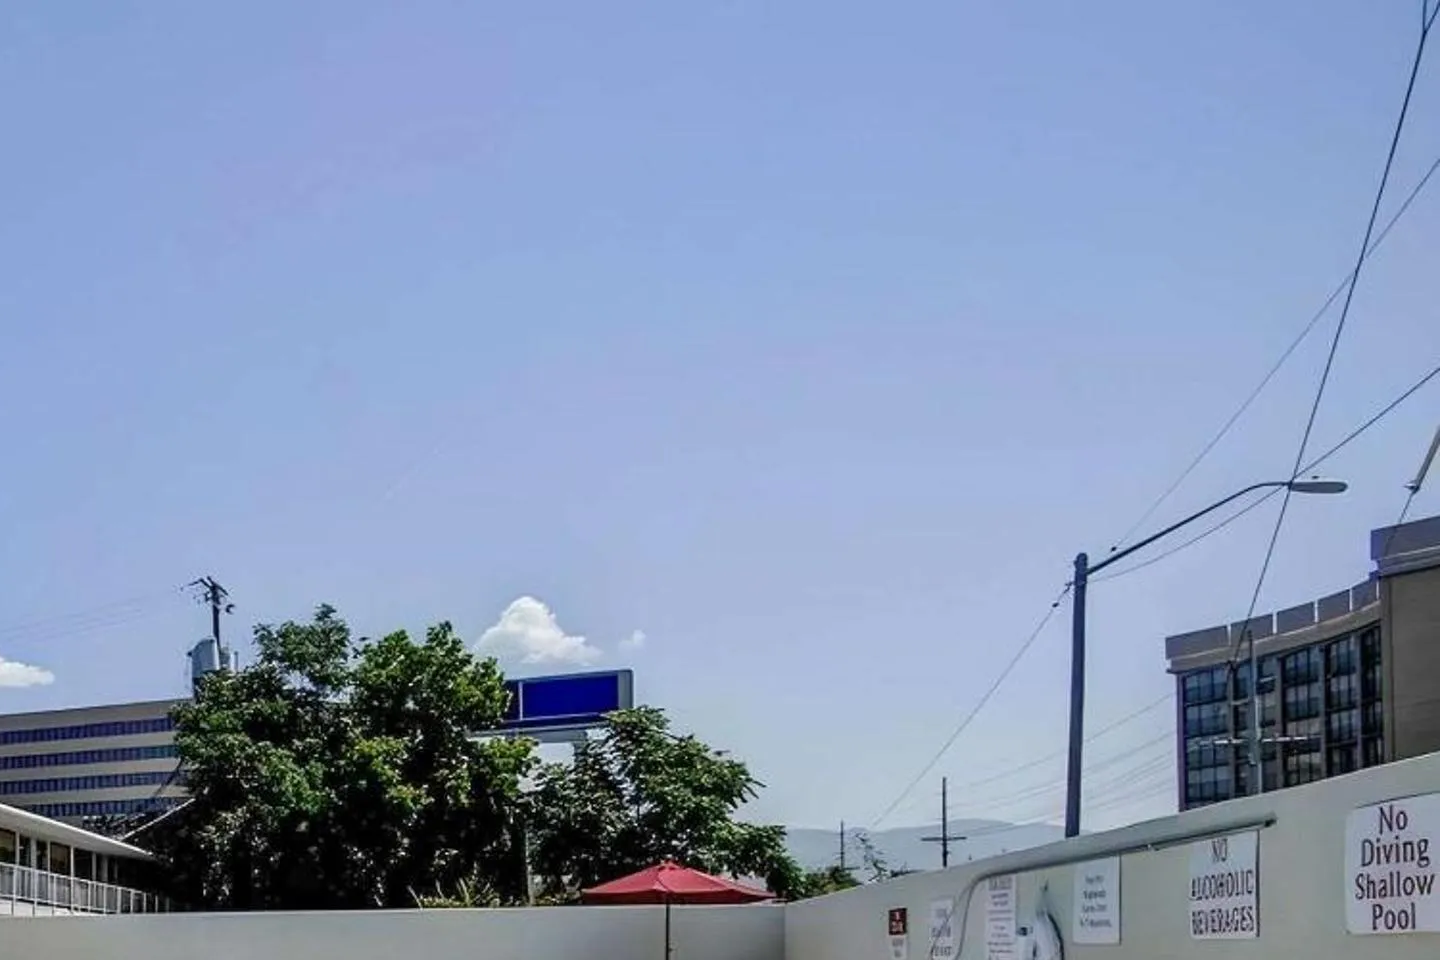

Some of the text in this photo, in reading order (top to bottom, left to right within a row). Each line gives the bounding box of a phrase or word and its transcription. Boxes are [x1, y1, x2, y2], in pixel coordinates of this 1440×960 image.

[1378, 804, 1408, 834] No
[1211, 838, 1228, 862] NO
[1361, 836, 1430, 868] Diving
[1191, 870, 1253, 900] ALCOHOLIC
[1355, 871, 1435, 900] Shallow
[1191, 906, 1254, 935] BEVERAGES
[1372, 903, 1416, 931] Pool
